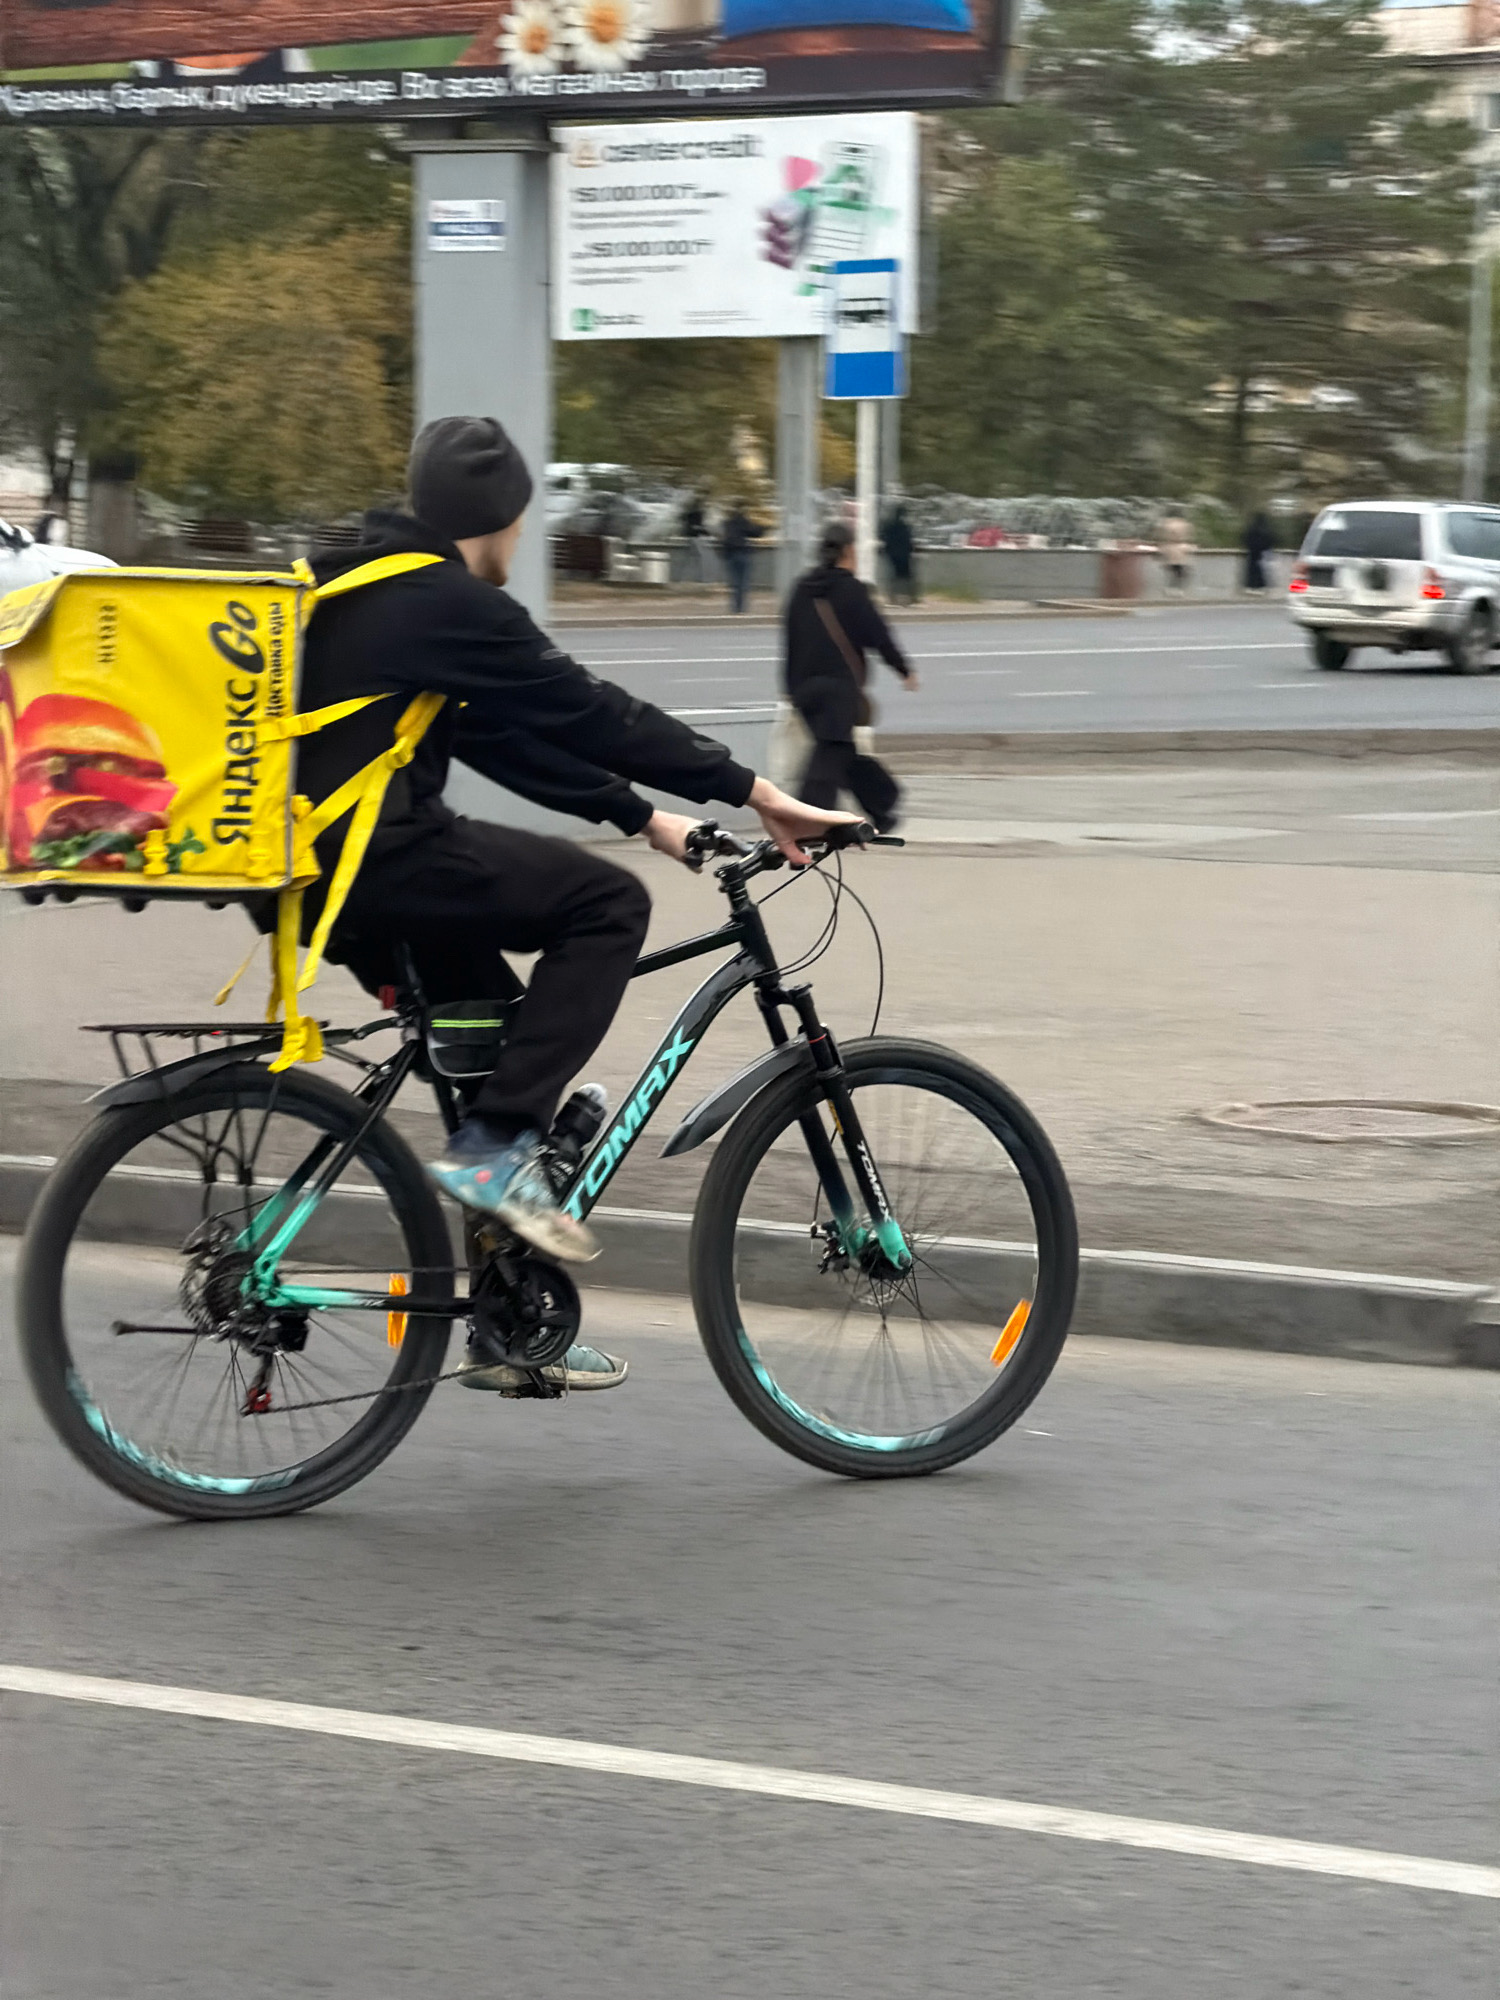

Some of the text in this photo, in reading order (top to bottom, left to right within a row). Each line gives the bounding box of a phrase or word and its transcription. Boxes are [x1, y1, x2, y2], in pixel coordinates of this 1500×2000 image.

[208, 599, 266, 846] Яндекс Go
[264, 602, 287, 718] Доставка еды
[560, 1024, 696, 1222] TOMAX
[857, 1139, 893, 1224] TOMAX
